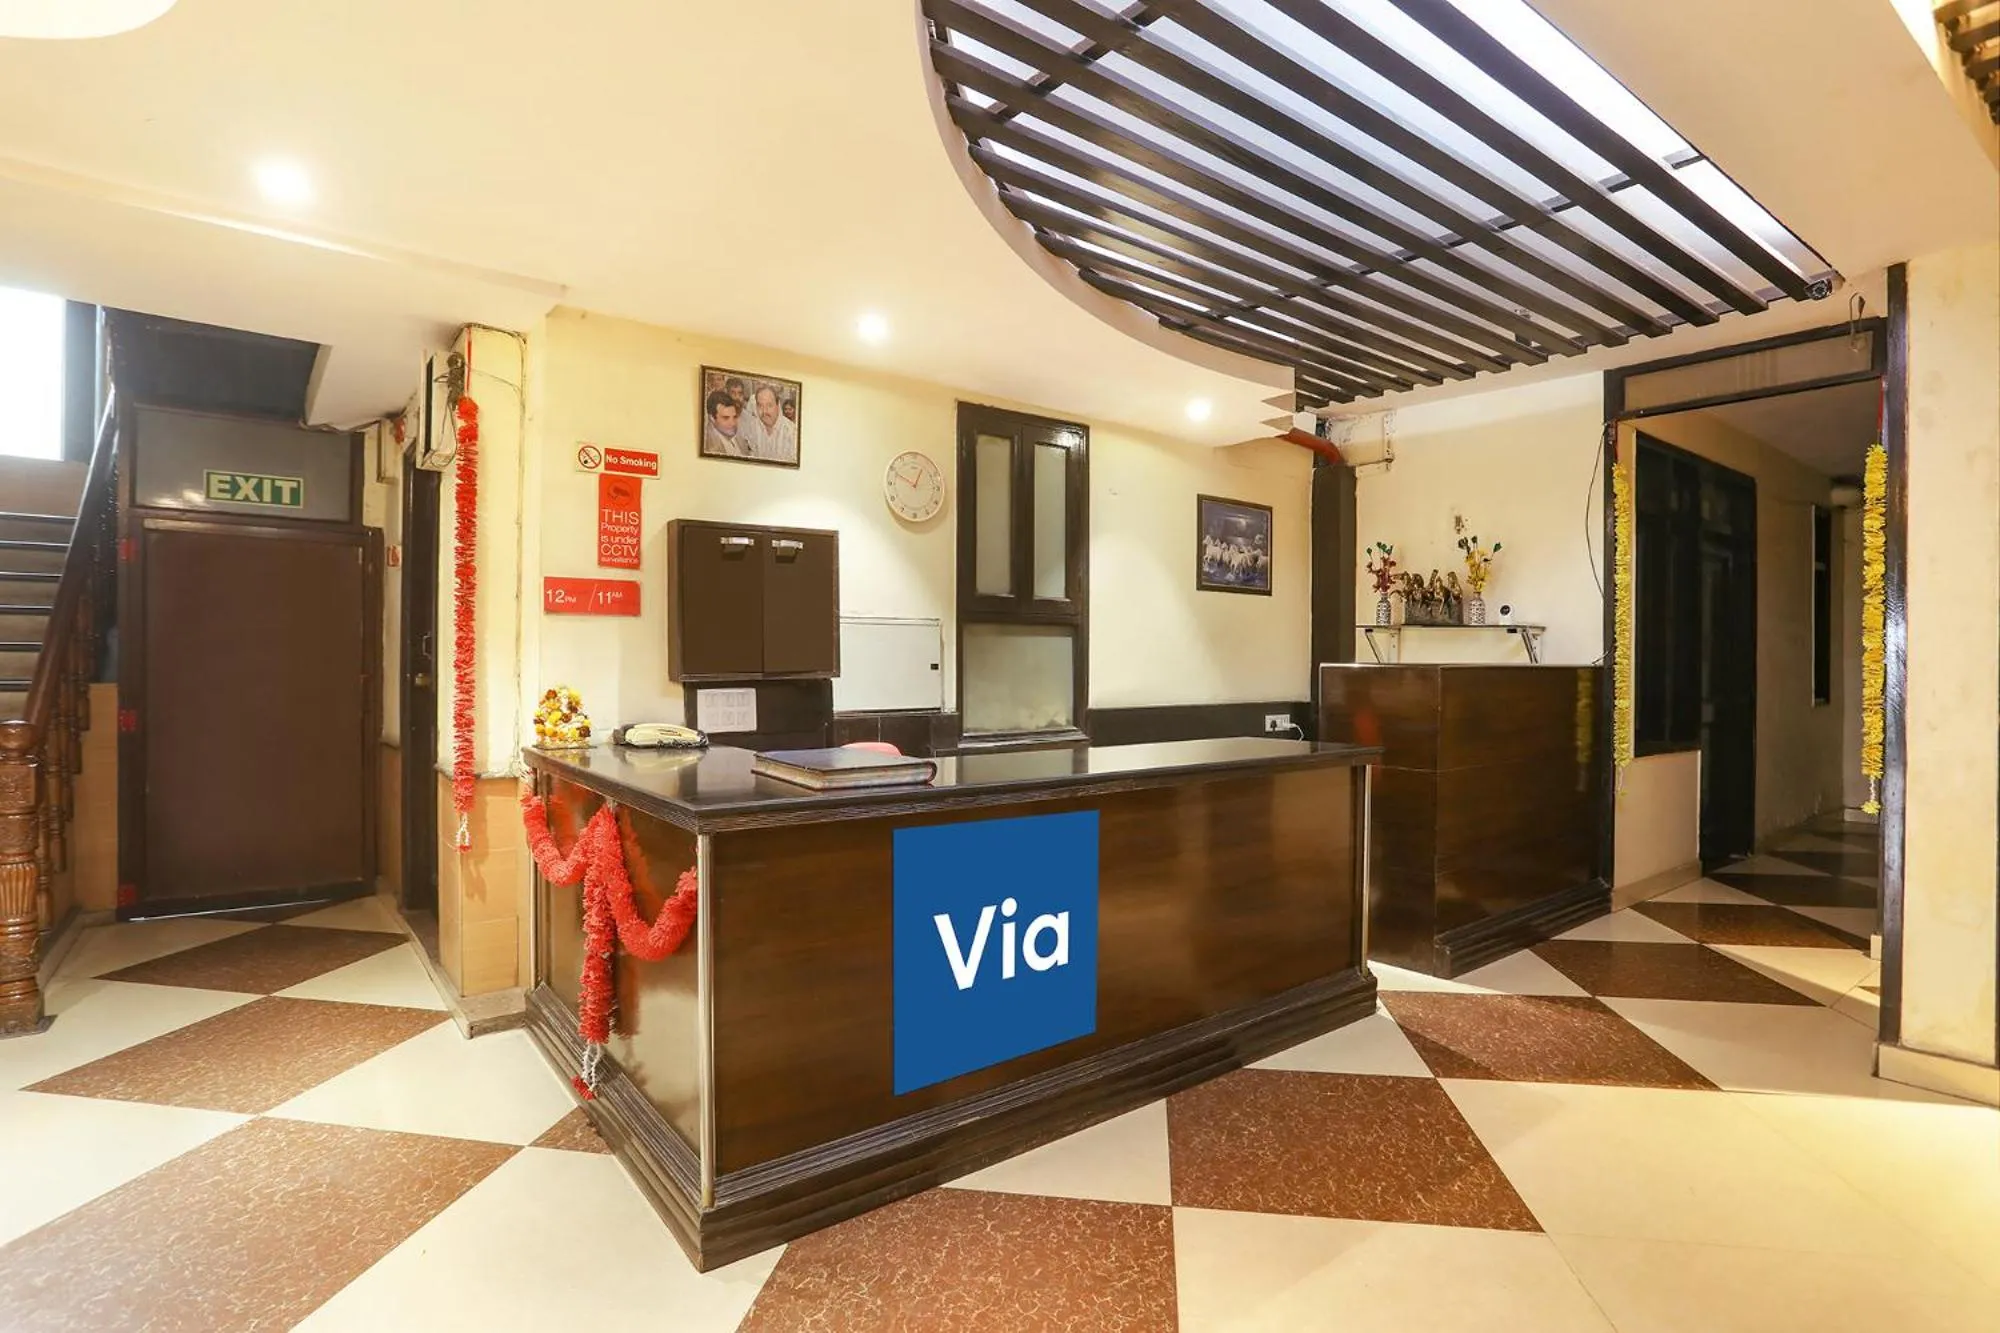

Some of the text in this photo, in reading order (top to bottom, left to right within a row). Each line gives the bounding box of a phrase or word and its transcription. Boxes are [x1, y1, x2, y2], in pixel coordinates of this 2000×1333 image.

[606, 454, 657, 470] No Smoking
[209, 473, 298, 505] EXIT
[601, 508, 640, 526] THIS
[601, 522, 639, 536] Property
[611, 535, 639, 545] under
[600, 543, 639, 556] CCTV
[933, 897, 1070, 990] Via
